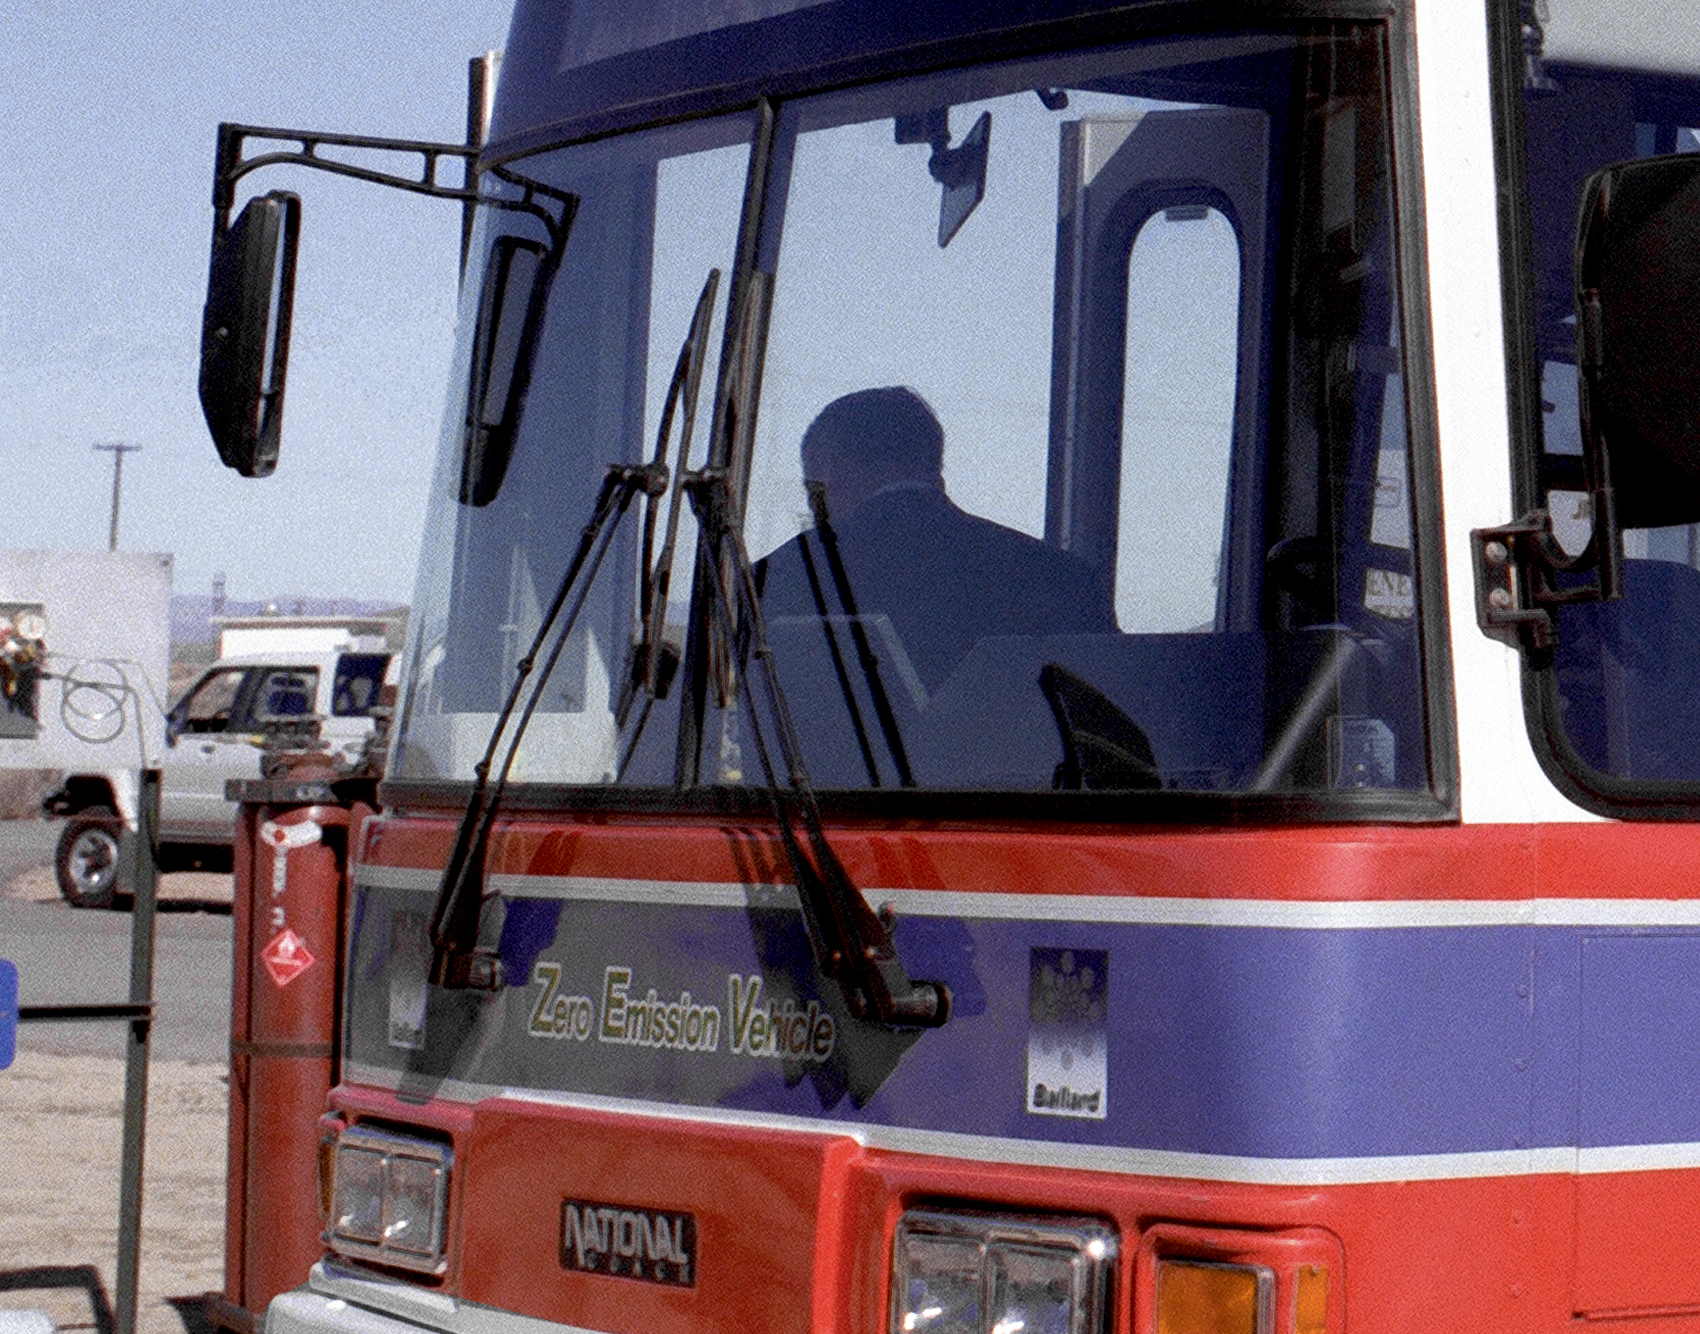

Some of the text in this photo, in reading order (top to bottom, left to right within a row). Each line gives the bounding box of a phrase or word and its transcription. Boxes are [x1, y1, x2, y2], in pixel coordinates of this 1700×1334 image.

[528, 962, 836, 1063] Zero Emission Vehicle
[1032, 1082, 1102, 1113] Ballard
[565, 1204, 689, 1267] NATIONAL
